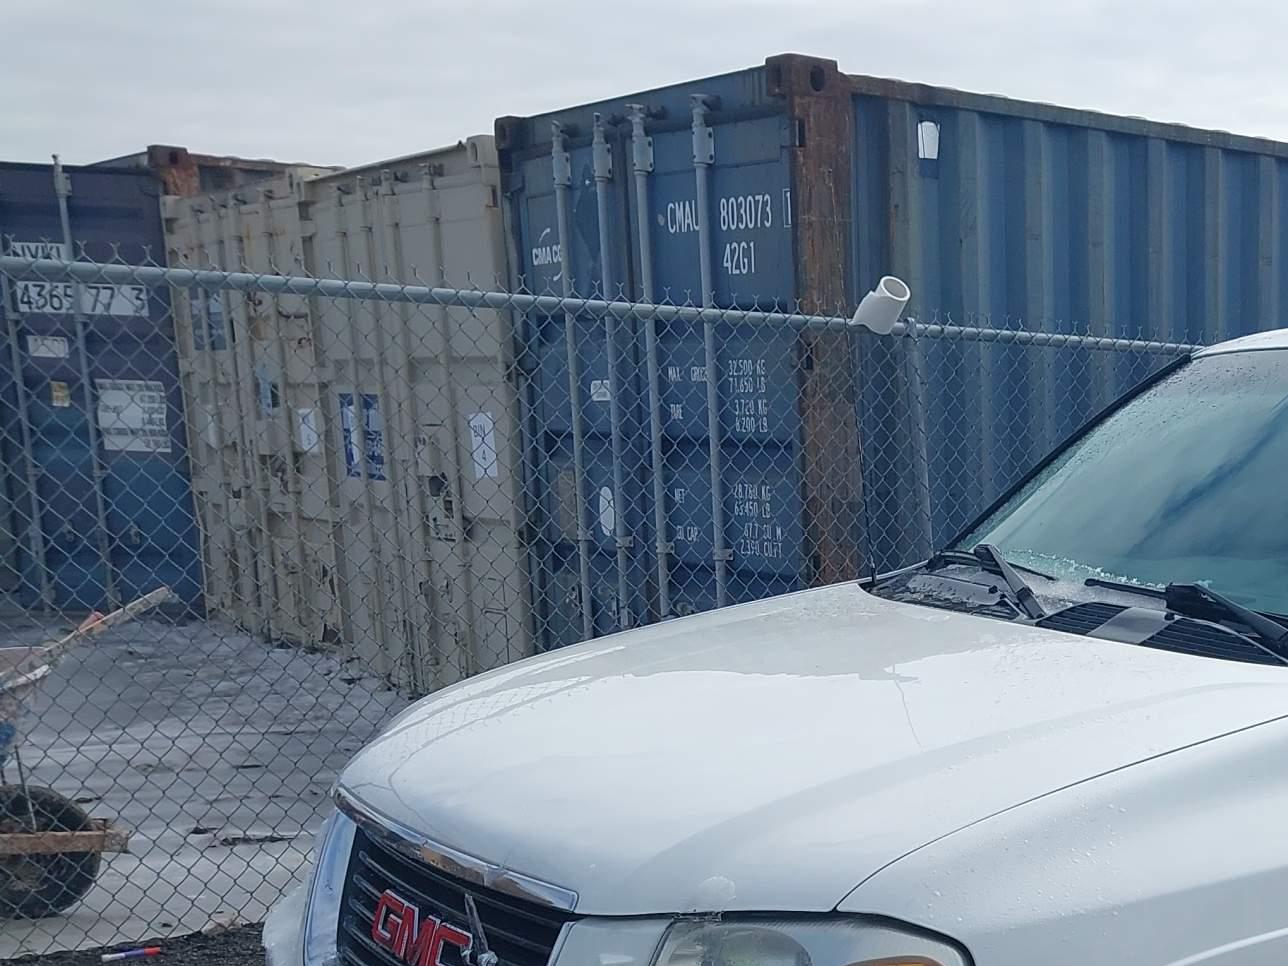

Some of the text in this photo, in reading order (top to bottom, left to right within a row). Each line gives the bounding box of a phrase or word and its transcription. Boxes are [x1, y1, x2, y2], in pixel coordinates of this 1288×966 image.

[667, 200, 700, 234] CMAU
[720, 194, 772, 231] 803073
[532, 246, 553, 266] CMA
[723, 241, 756, 275] 42G1
[131, 287, 145, 314] 3
